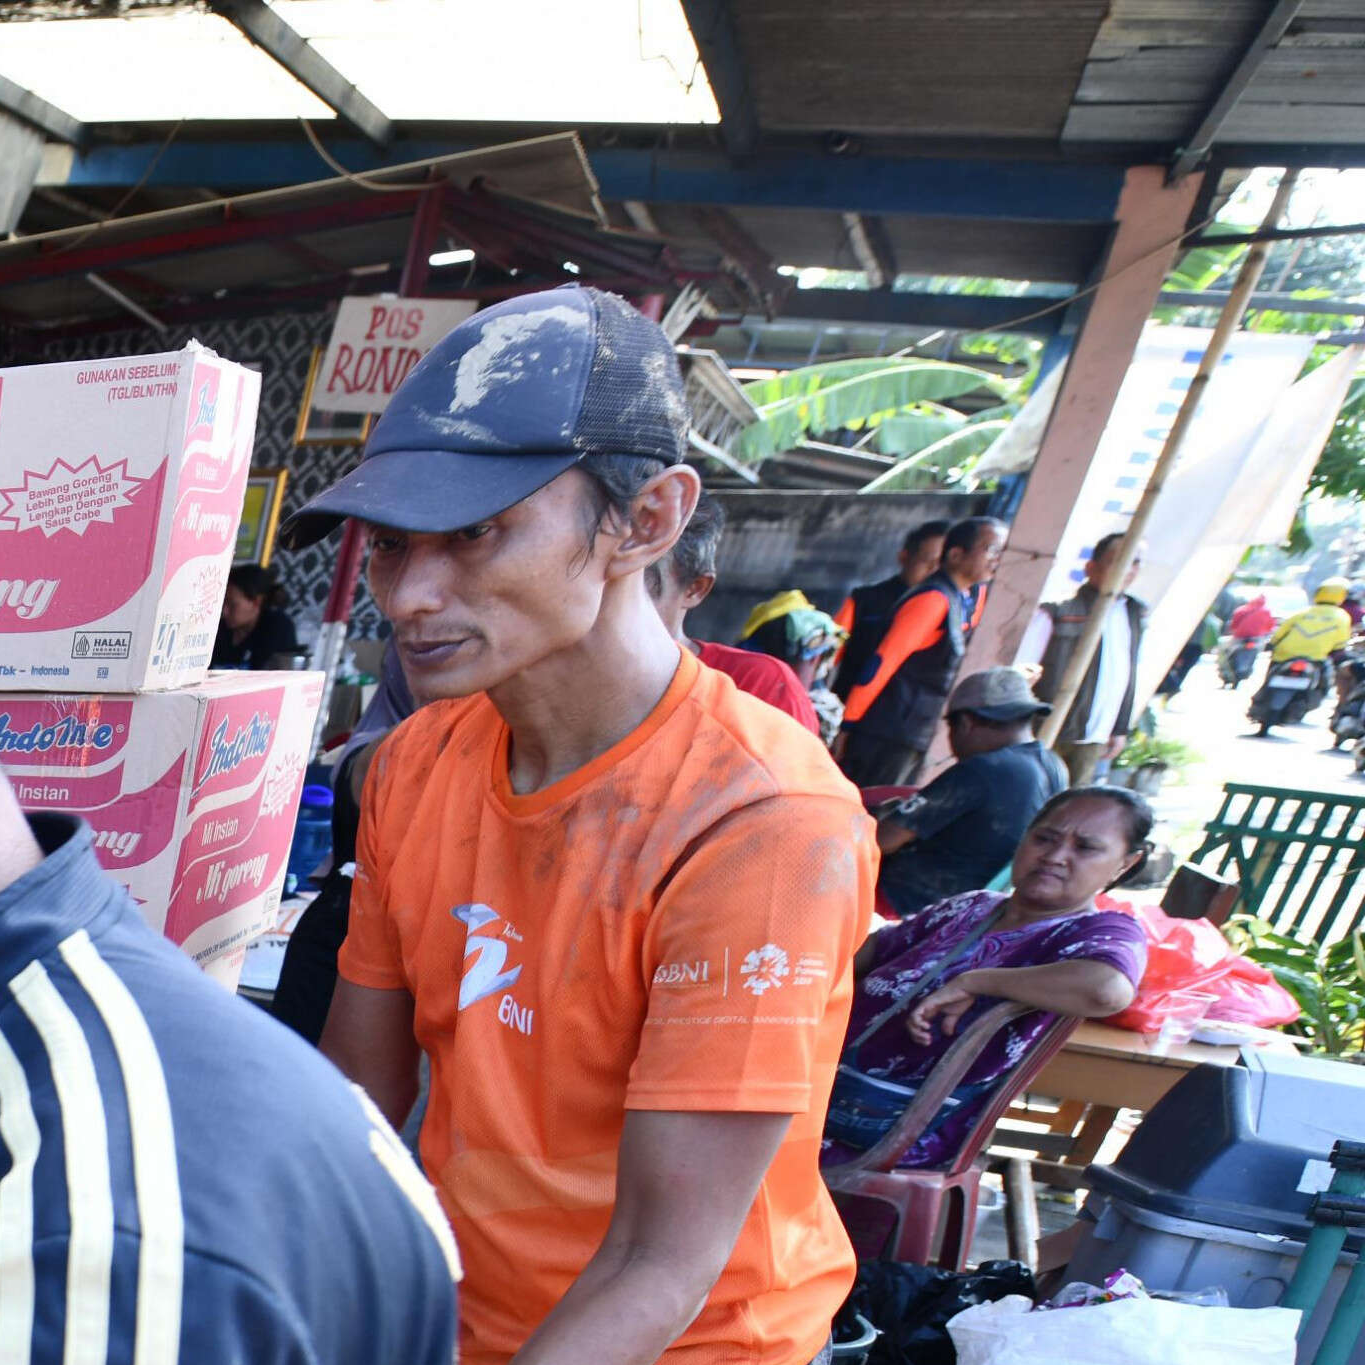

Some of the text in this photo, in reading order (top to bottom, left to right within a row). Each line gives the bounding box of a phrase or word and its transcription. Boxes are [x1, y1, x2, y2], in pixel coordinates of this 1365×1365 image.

[365, 305, 425, 341] POS
[76, 367, 126, 385] GUNAKAN
[326, 343, 422, 395] ROND
[107, 382, 178, 404] (TGL/BLN/THN)
[25, 481, 119, 513] Lebih Banyak dan
[28, 472, 113, 500] Bawang Goreng
[28, 494, 117, 523] Lengkap Dengan
[44, 508, 101, 529] Saus Cabe
[93, 638, 128, 647] HALAL
[30, 666, 70, 676] Indonesia
[19, 784, 69, 801] Instan
[213, 818, 239, 843] Instan
[219, 853, 269, 904] goreng
[666, 960, 709, 983] BNI
[498, 993, 534, 1036] BNI
